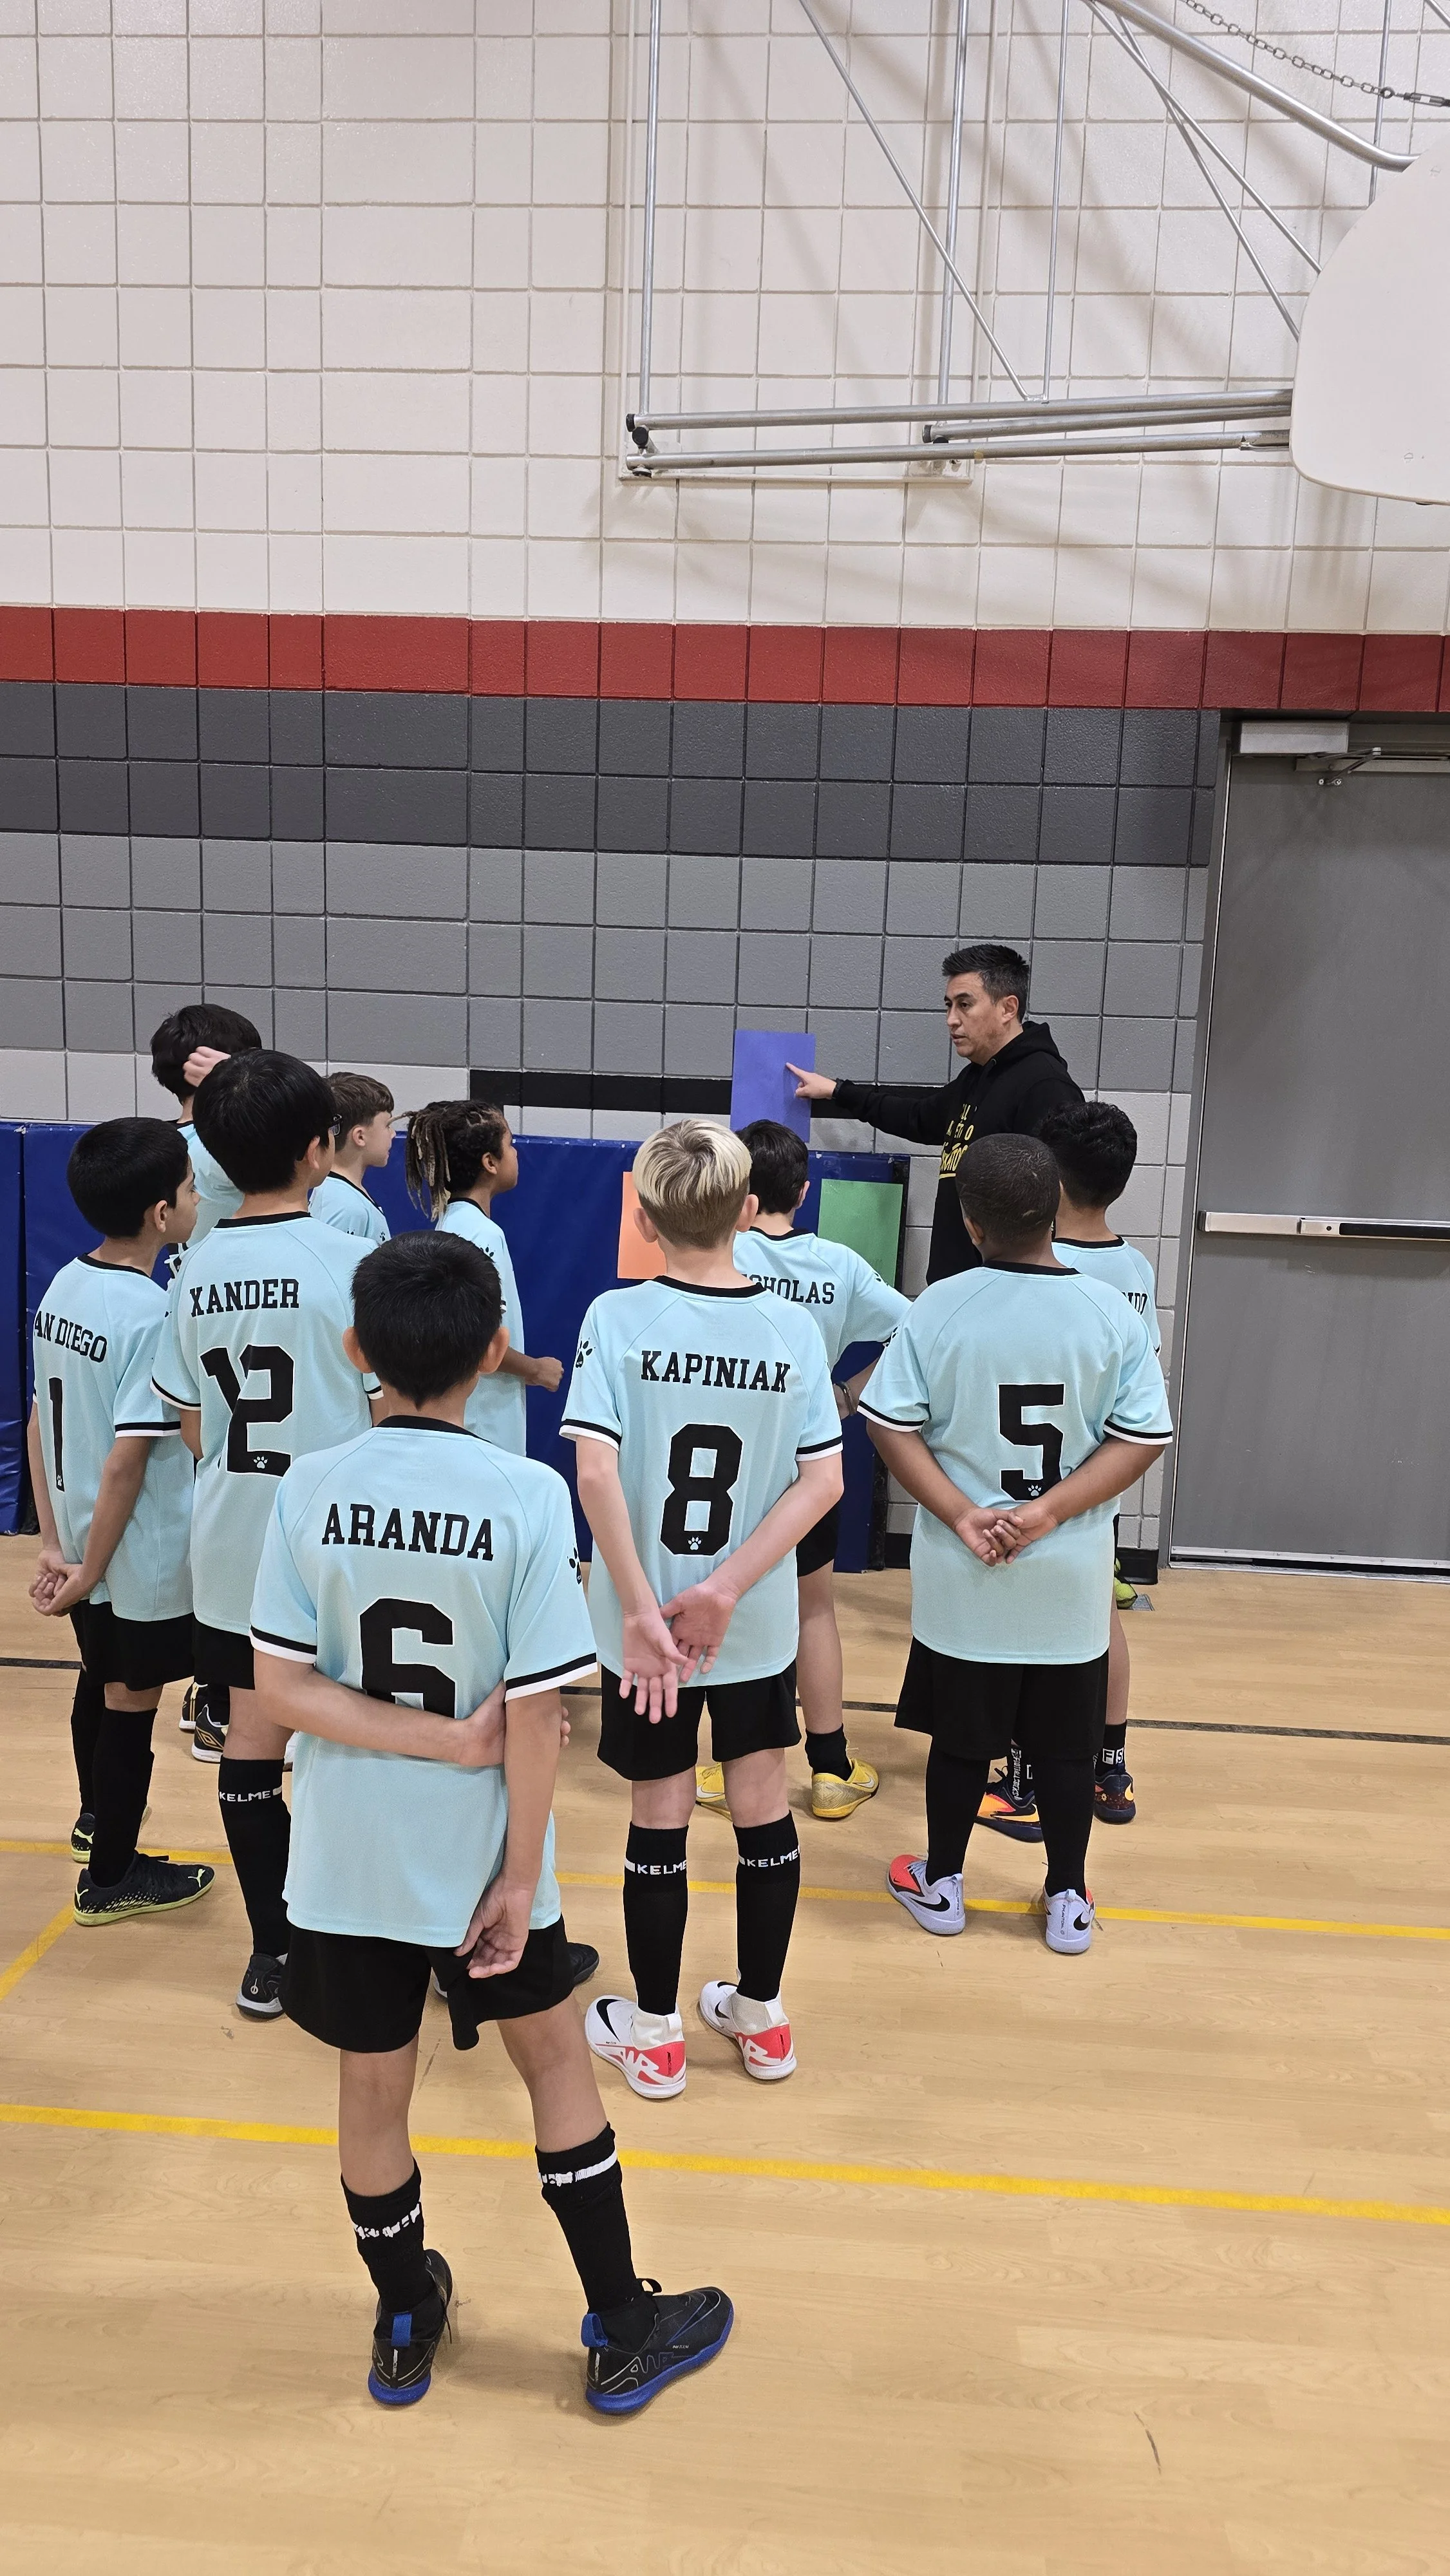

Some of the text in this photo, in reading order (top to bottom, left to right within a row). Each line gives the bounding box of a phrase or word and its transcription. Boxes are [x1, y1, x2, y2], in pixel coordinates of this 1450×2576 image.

[189, 1278, 299, 1318] XANDER
[55, 1318, 107, 1363] DIEGO
[641, 1350, 791, 1393] KAPINIAK
[48, 1377, 64, 1492] 1
[200, 1344, 294, 1477] 12
[997, 1383, 1066, 1501] 5
[659, 1423, 744, 1557] 8
[322, 1503, 493, 1561] ARANDA
[359, 1598, 456, 1719] 6
[220, 1790, 271, 1802] KELME
[637, 1859, 687, 1875] KELME
[747, 1848, 798, 1868] KELME
